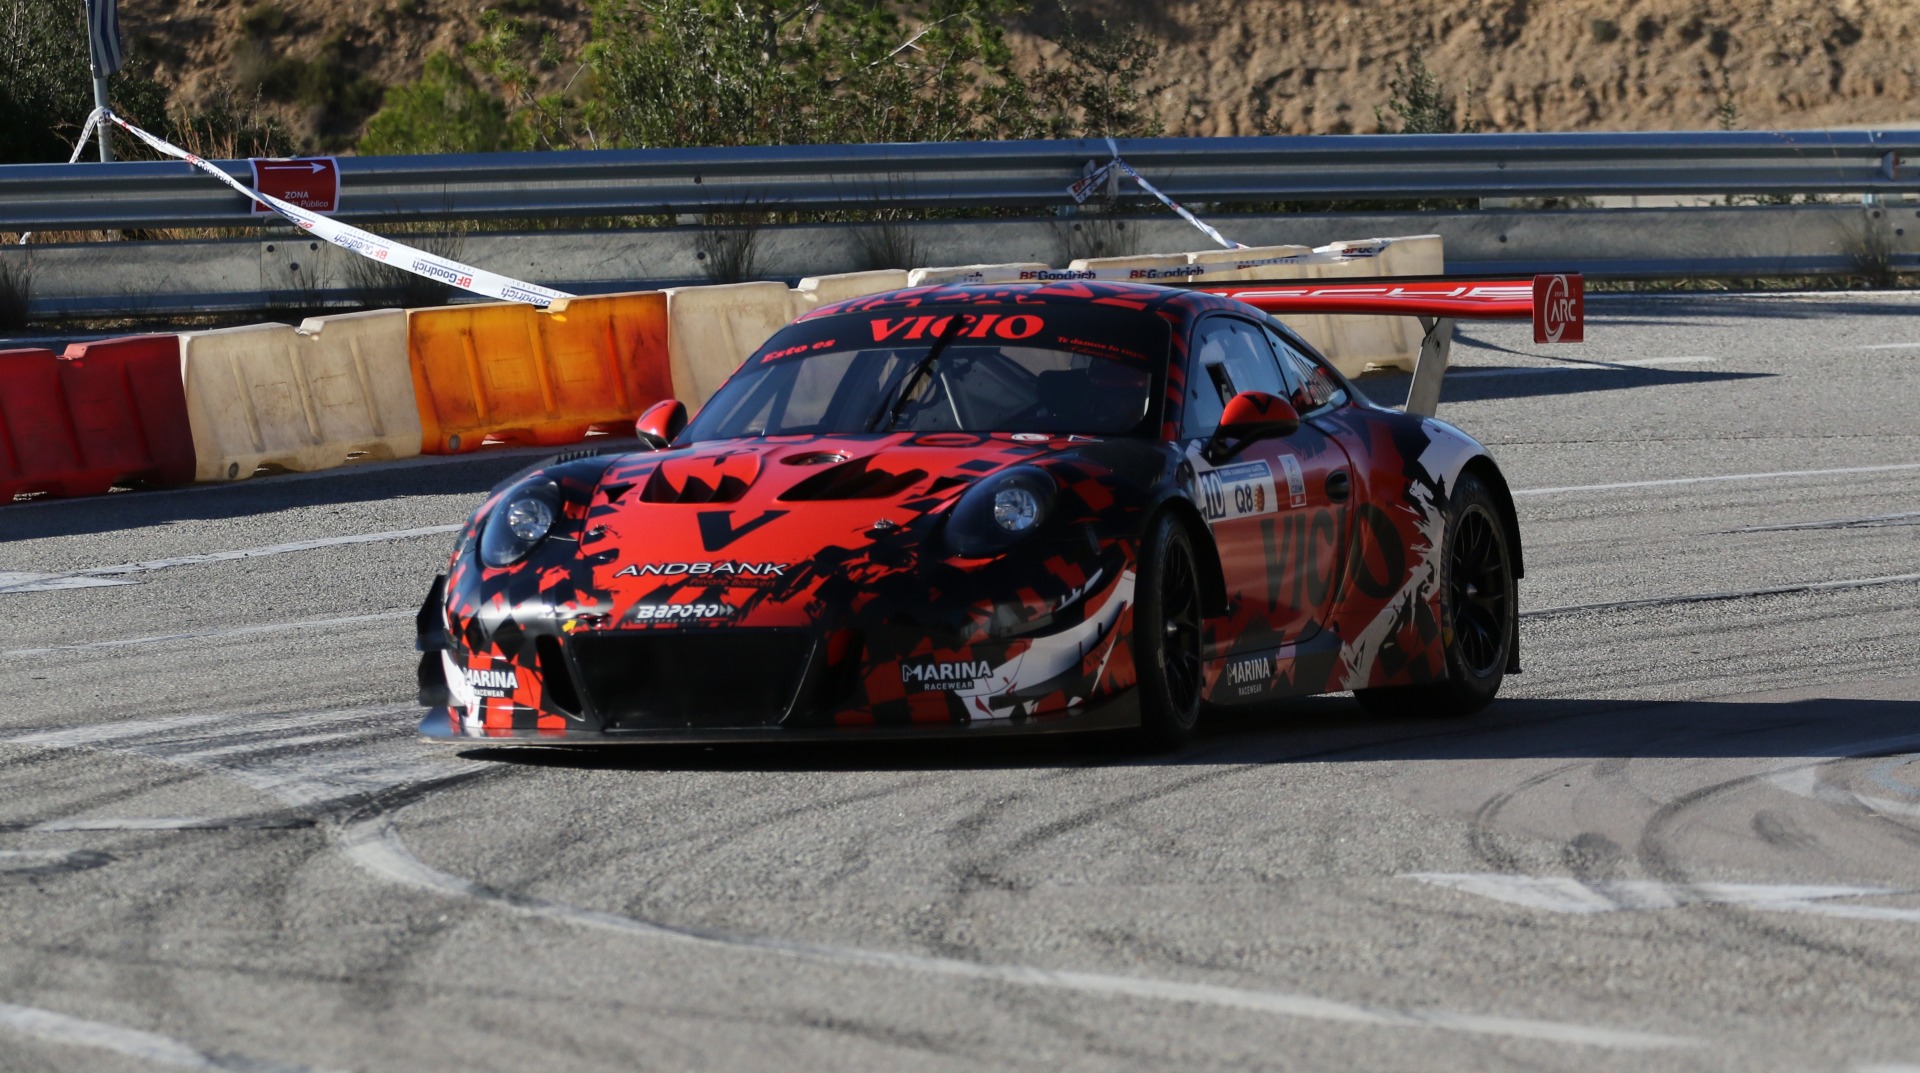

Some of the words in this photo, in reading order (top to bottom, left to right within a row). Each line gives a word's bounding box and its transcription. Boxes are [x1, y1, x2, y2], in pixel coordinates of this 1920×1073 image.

[301, 200, 329, 208] Público
[412, 259, 473, 289] BFGoodrich
[1020, 269, 1097, 280] BFGoodrich
[1129, 265, 1205, 280] BFGoodrich
[500, 287, 552, 307] Goodrich
[1550, 298, 1577, 322] ARC
[870, 314, 1045, 342] VICIO
[760, 341, 808, 364] Esto
[812, 338, 836, 350] es
[1201, 472, 1225, 516] 10
[1235, 483, 1253, 514] Q8
[697, 509, 792, 552] V
[613, 561, 789, 579] ANDBANK
[1259, 502, 1406, 615] VICIO
[690, 578, 728, 586] Private
[731, 578, 776, 588] Bankers
[463, 667, 519, 689] MARINA
[902, 660, 993, 683] MARINA
[1226, 657, 1271, 686] MARINA
[924, 681, 973, 691] RACEWEAR
[1238, 683, 1263, 696] RACEWEAR
